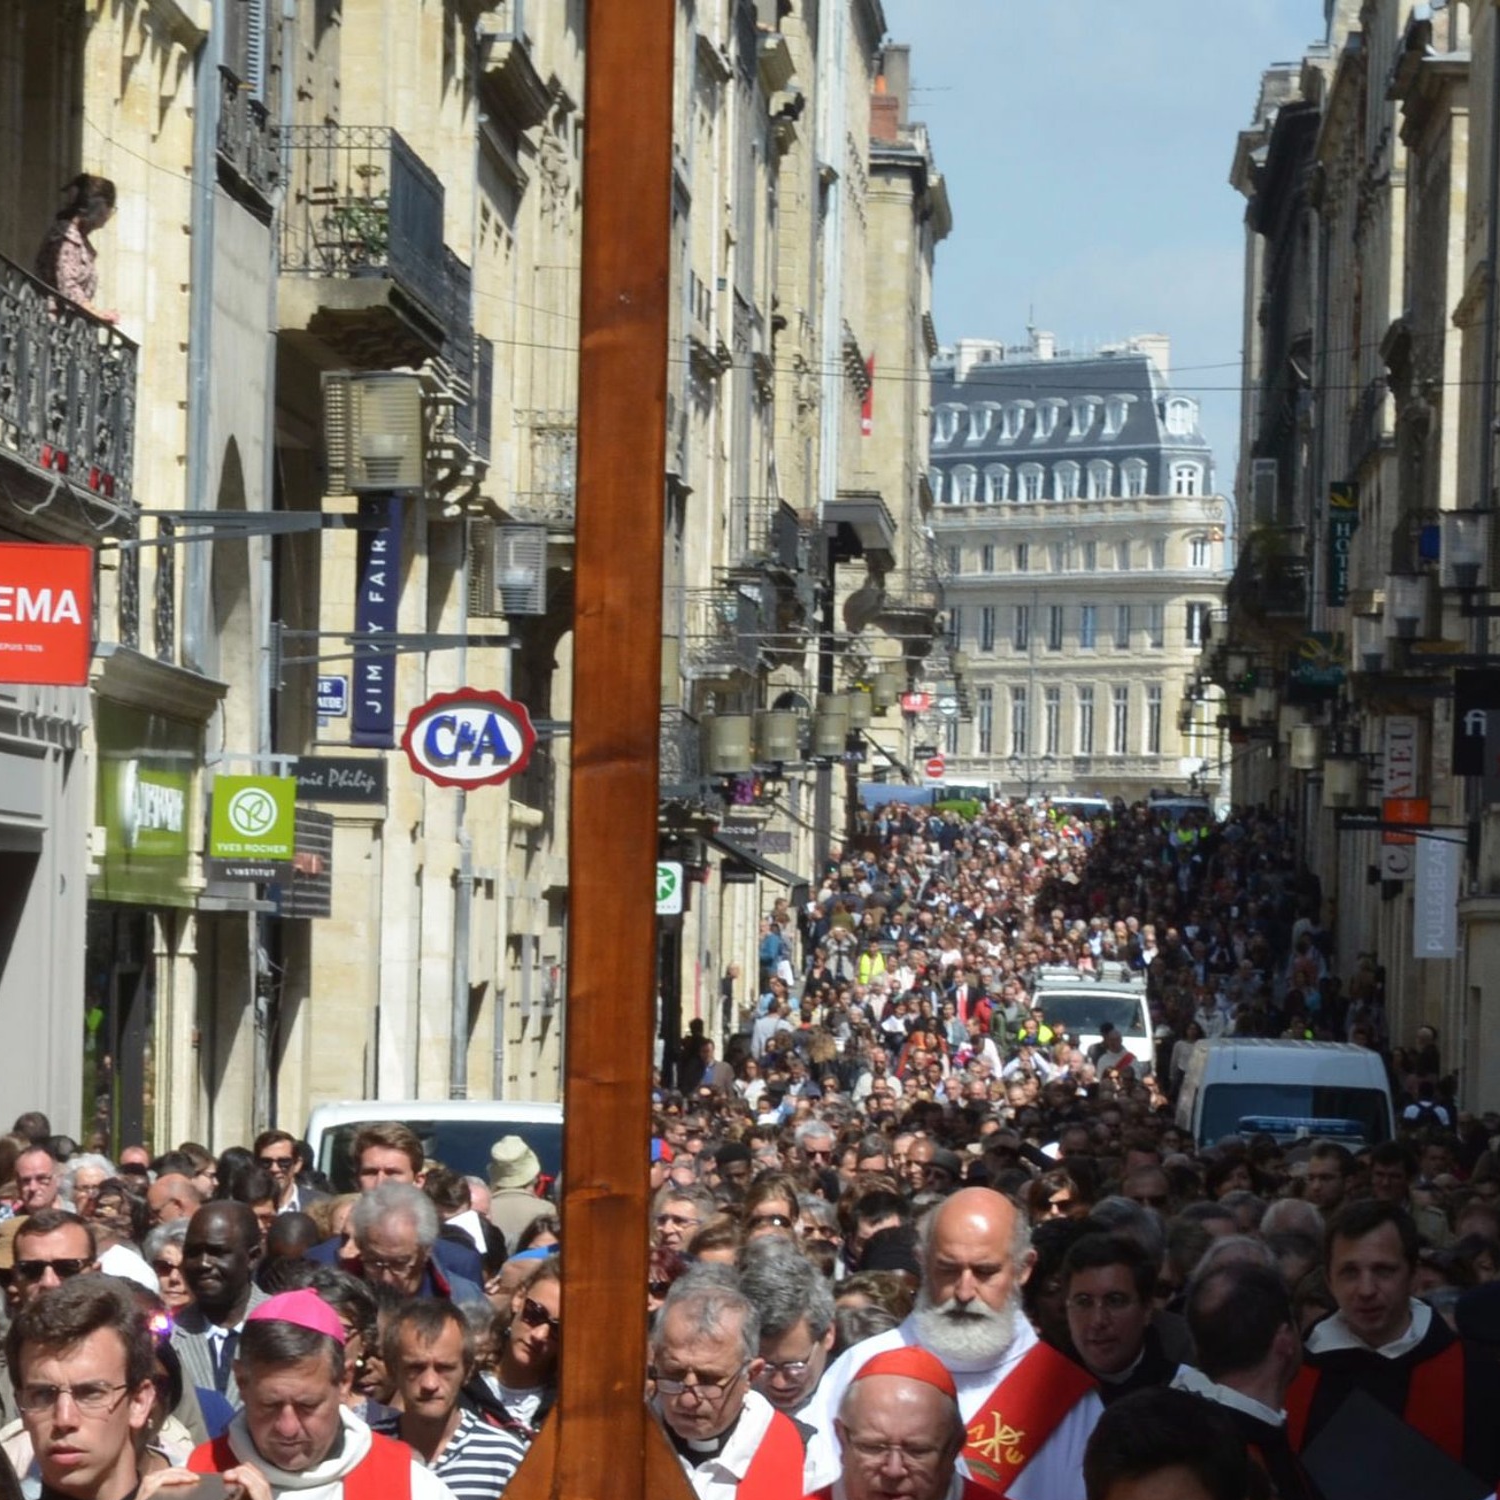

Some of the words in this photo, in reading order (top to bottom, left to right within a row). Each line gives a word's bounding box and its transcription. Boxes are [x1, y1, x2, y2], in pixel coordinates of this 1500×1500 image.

[368, 520, 388, 603] FAIR
[423, 711, 513, 767] C&A
[217, 843, 242, 853] YVES
[244, 844, 288, 854] ROCHER
